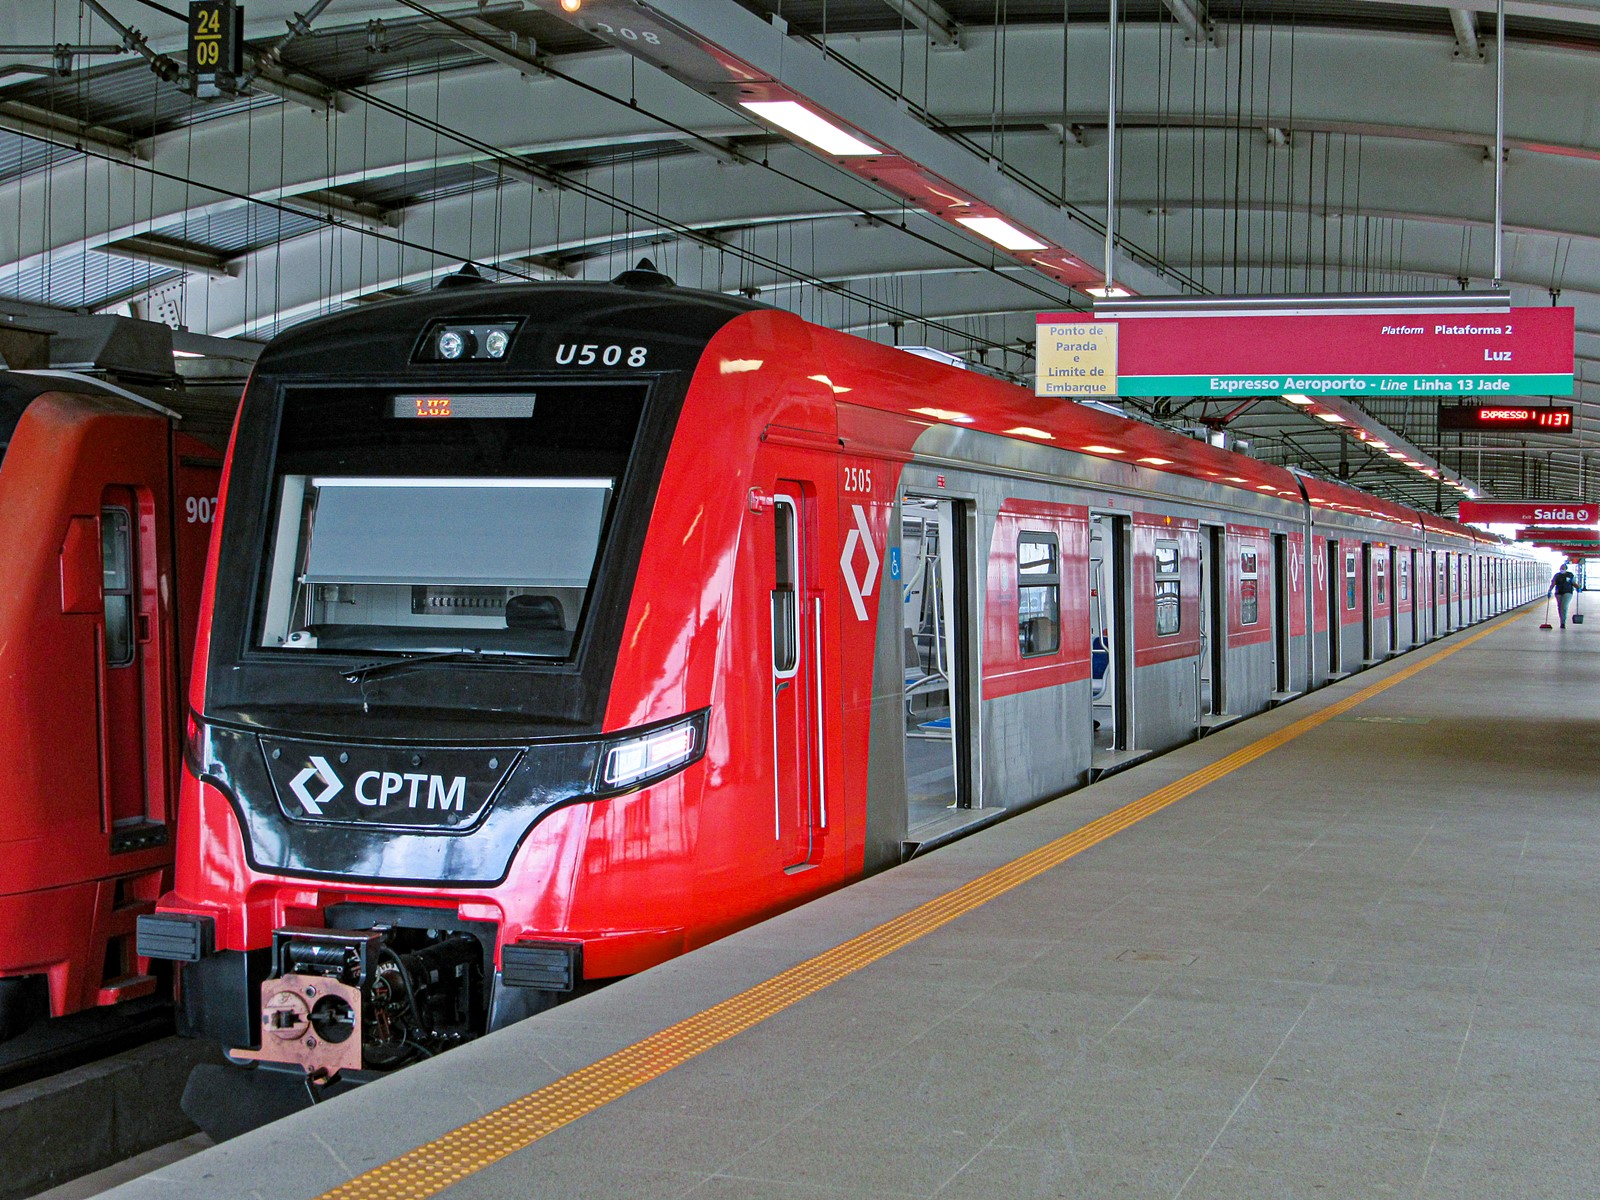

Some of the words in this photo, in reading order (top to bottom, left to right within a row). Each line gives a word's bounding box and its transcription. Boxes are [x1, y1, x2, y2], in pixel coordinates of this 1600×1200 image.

[197, 9, 220, 33] 24
[197, 41, 219, 65] 09
[1050, 326, 1085, 336] Ponto
[1089, 326, 1104, 335] de
[1381, 325, 1424, 335] Platform
[1434, 325, 1502, 335] Plataforma
[1505, 325, 1513, 335] 2
[1056, 341, 1097, 351] Parada
[555, 344, 648, 367] U508
[1073, 355, 1080, 363] e
[1484, 349, 1512, 361] Luz
[1048, 366, 1086, 377] Limite
[1090, 366, 1104, 377] de
[1046, 382, 1106, 394] Embarque
[1210, 378, 1279, 392] Expresso
[1284, 377, 1366, 392] Aeroporto
[1380, 379, 1408, 391] Line
[1413, 379, 1452, 391] Linha
[1457, 379, 1474, 391] 13
[1477, 378, 1510, 391] Jade
[416, 399, 451, 416] LUZ
[1480, 410, 1528, 419] EXPRESSO
[844, 467, 871, 493] 2505
[1534, 508, 1575, 520] Saída
[354, 770, 466, 811] CPTM
